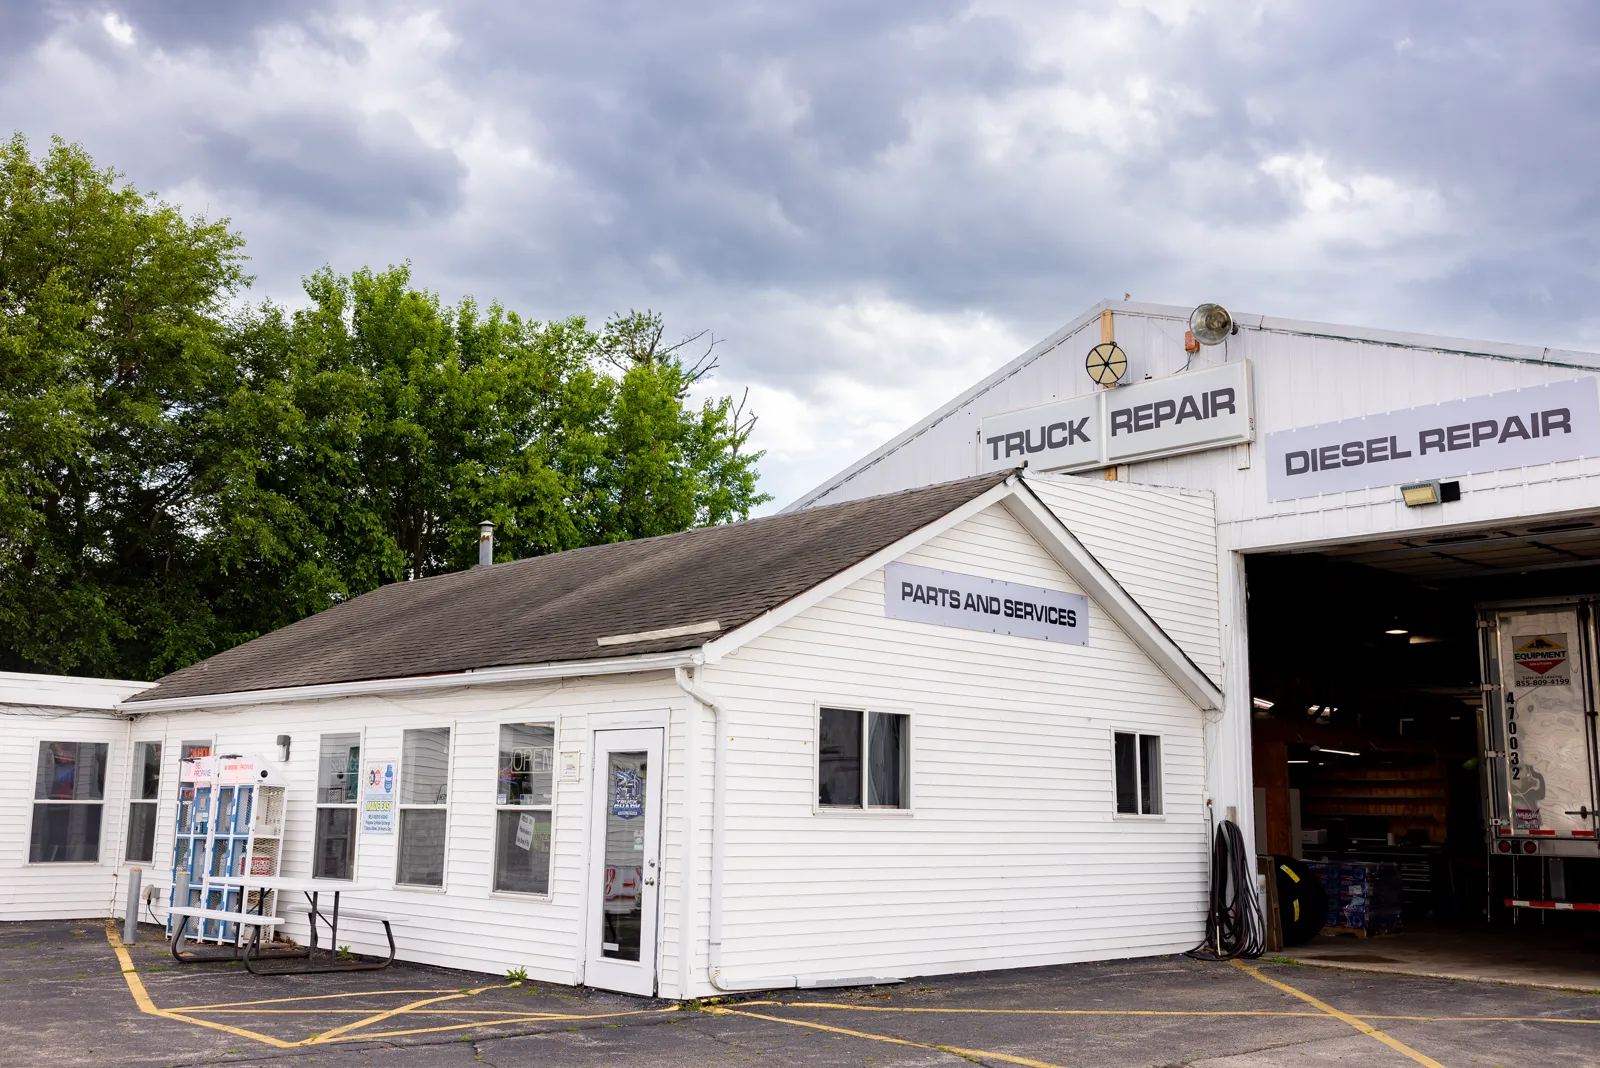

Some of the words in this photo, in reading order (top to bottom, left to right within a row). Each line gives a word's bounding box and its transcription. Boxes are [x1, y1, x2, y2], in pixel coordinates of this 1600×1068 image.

[986, 416, 1092, 461] TRUCK
[1110, 387, 1236, 437] REPAIR
[1285, 435, 1412, 477] DIESEL
[1418, 407, 1572, 456] REPAIR
[901, 581, 961, 610] PARTS
[963, 592, 1001, 616] AND
[1003, 598, 1077, 628] SERVICES
[1514, 651, 1567, 660] EQUIPMENT
[1515, 678, 1570, 687] 855-809-4199
[1506, 692, 1520, 780] 470032
[513, 749, 553, 771] OPEN
